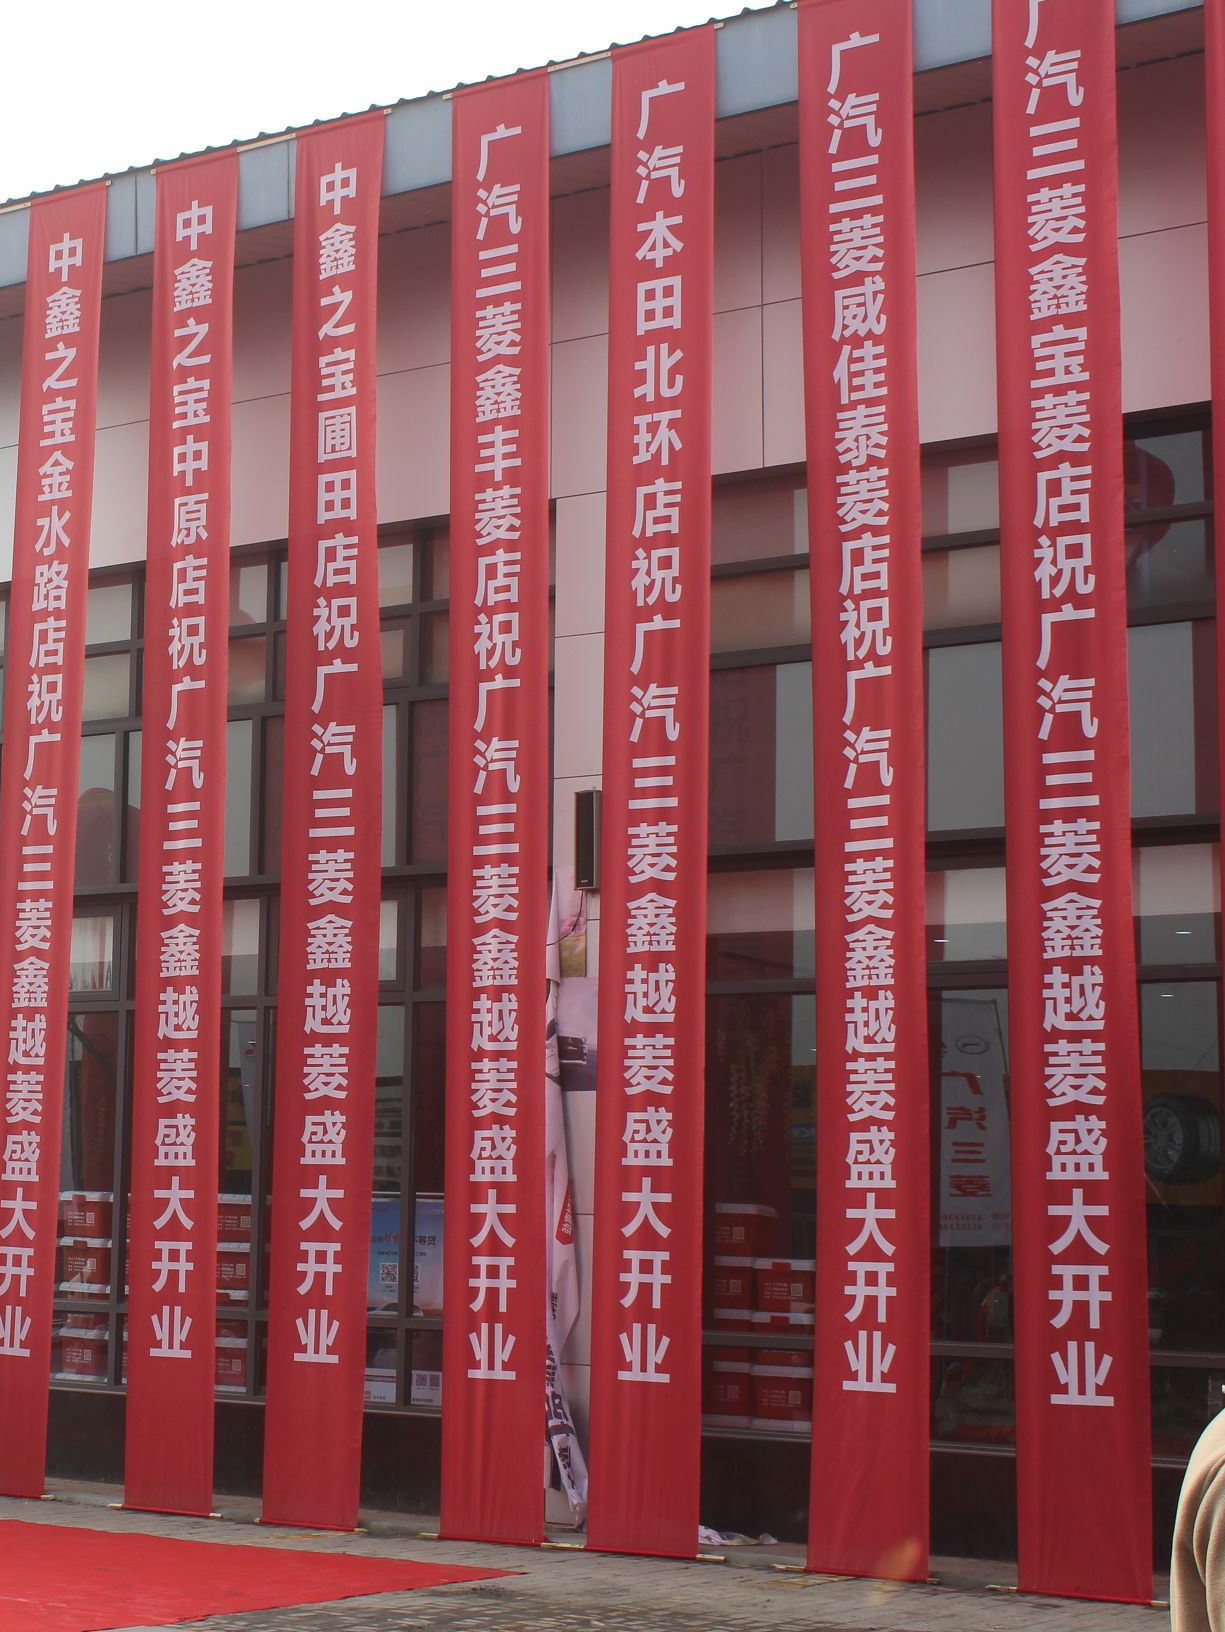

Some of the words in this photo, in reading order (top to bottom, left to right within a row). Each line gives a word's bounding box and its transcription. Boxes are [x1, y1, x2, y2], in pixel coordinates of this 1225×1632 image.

[149, 198, 214, 1359] 中鑫之宝中原店祝广汽三菱鑫越菱盛大开业
[293, 161, 360, 1364] 中鑫之宝圃田店祝广汽三菱鑫越菱盛大开业
[467, 123, 523, 1380] 广汽三菱鑫丰菱店祝广汽三菱鑫越菱盛大开业
[617, 79, 686, 1383] 广汽本田北环店祝广汽三菱鑫越菱盛大开业
[826, 31, 897, 1393] 广汽三菱威佳泰菱店祝广汽三菱鑫越菱盛大开业
